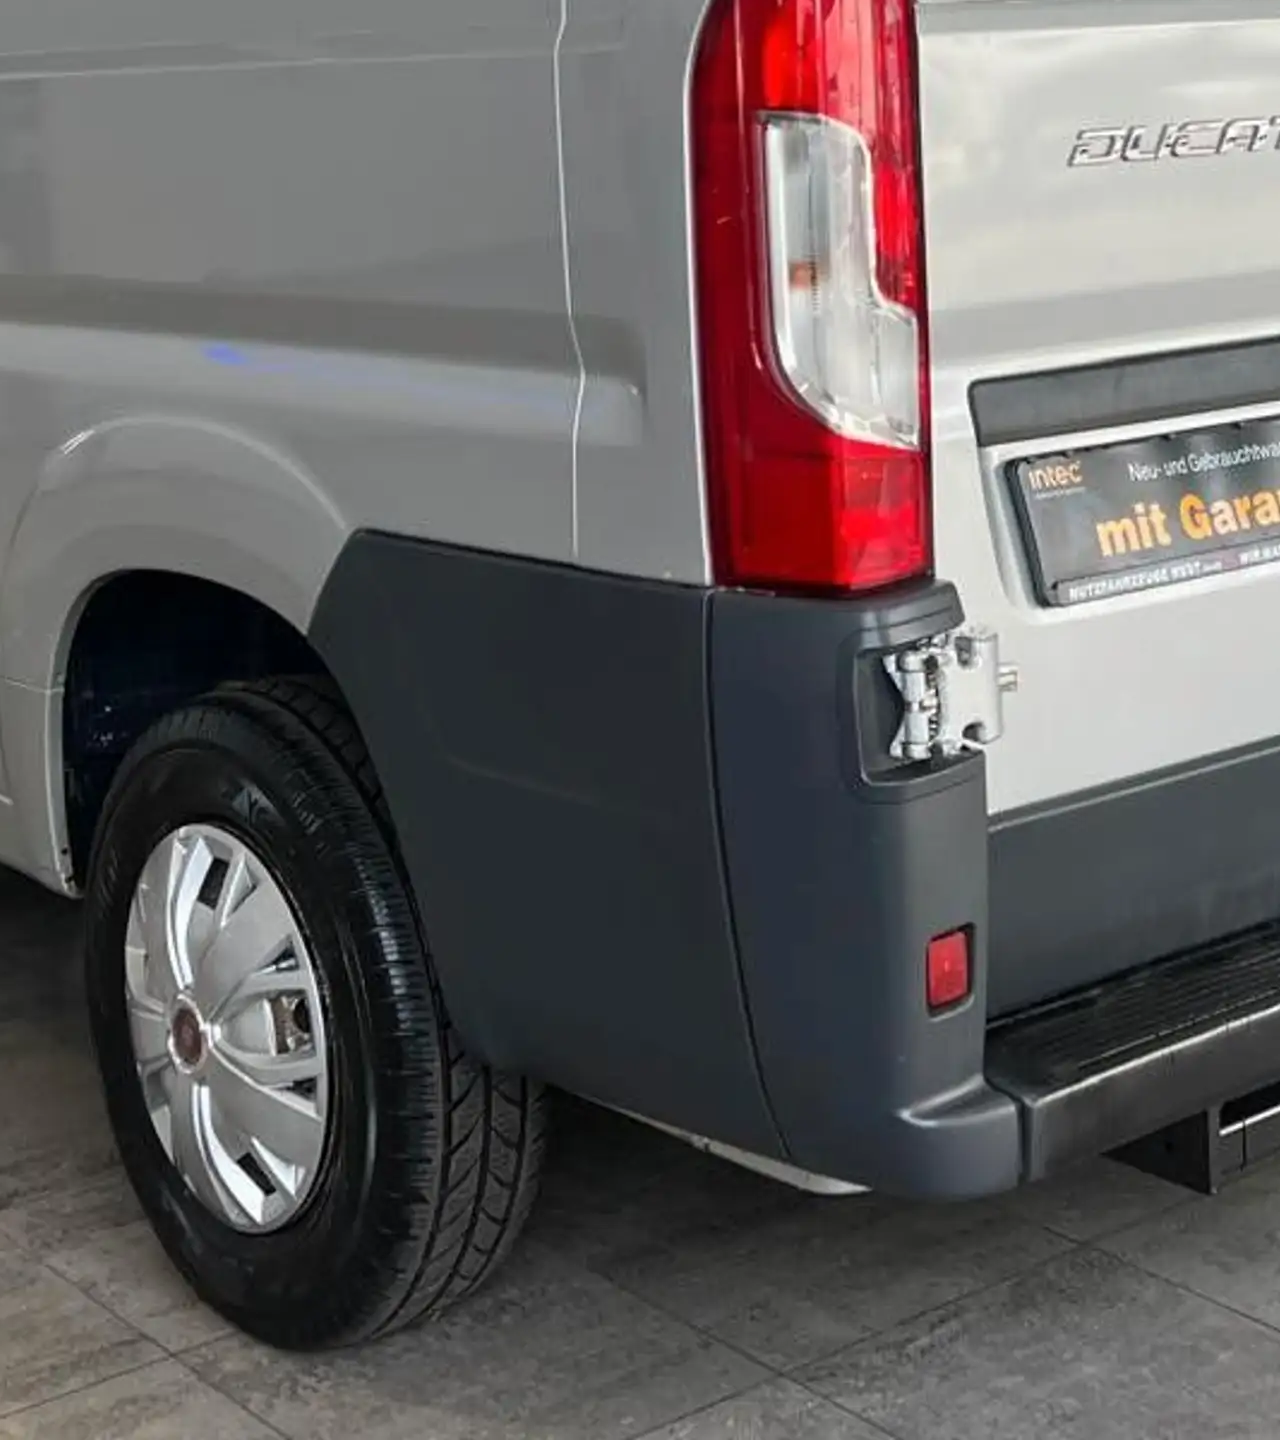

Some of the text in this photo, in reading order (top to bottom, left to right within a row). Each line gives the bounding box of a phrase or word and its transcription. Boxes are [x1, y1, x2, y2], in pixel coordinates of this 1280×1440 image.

[1028, 461, 1083, 490] intec
[1128, 463, 1161, 481] Neu-
[1163, 456, 1186, 476] und
[1095, 503, 1173, 557] mit
